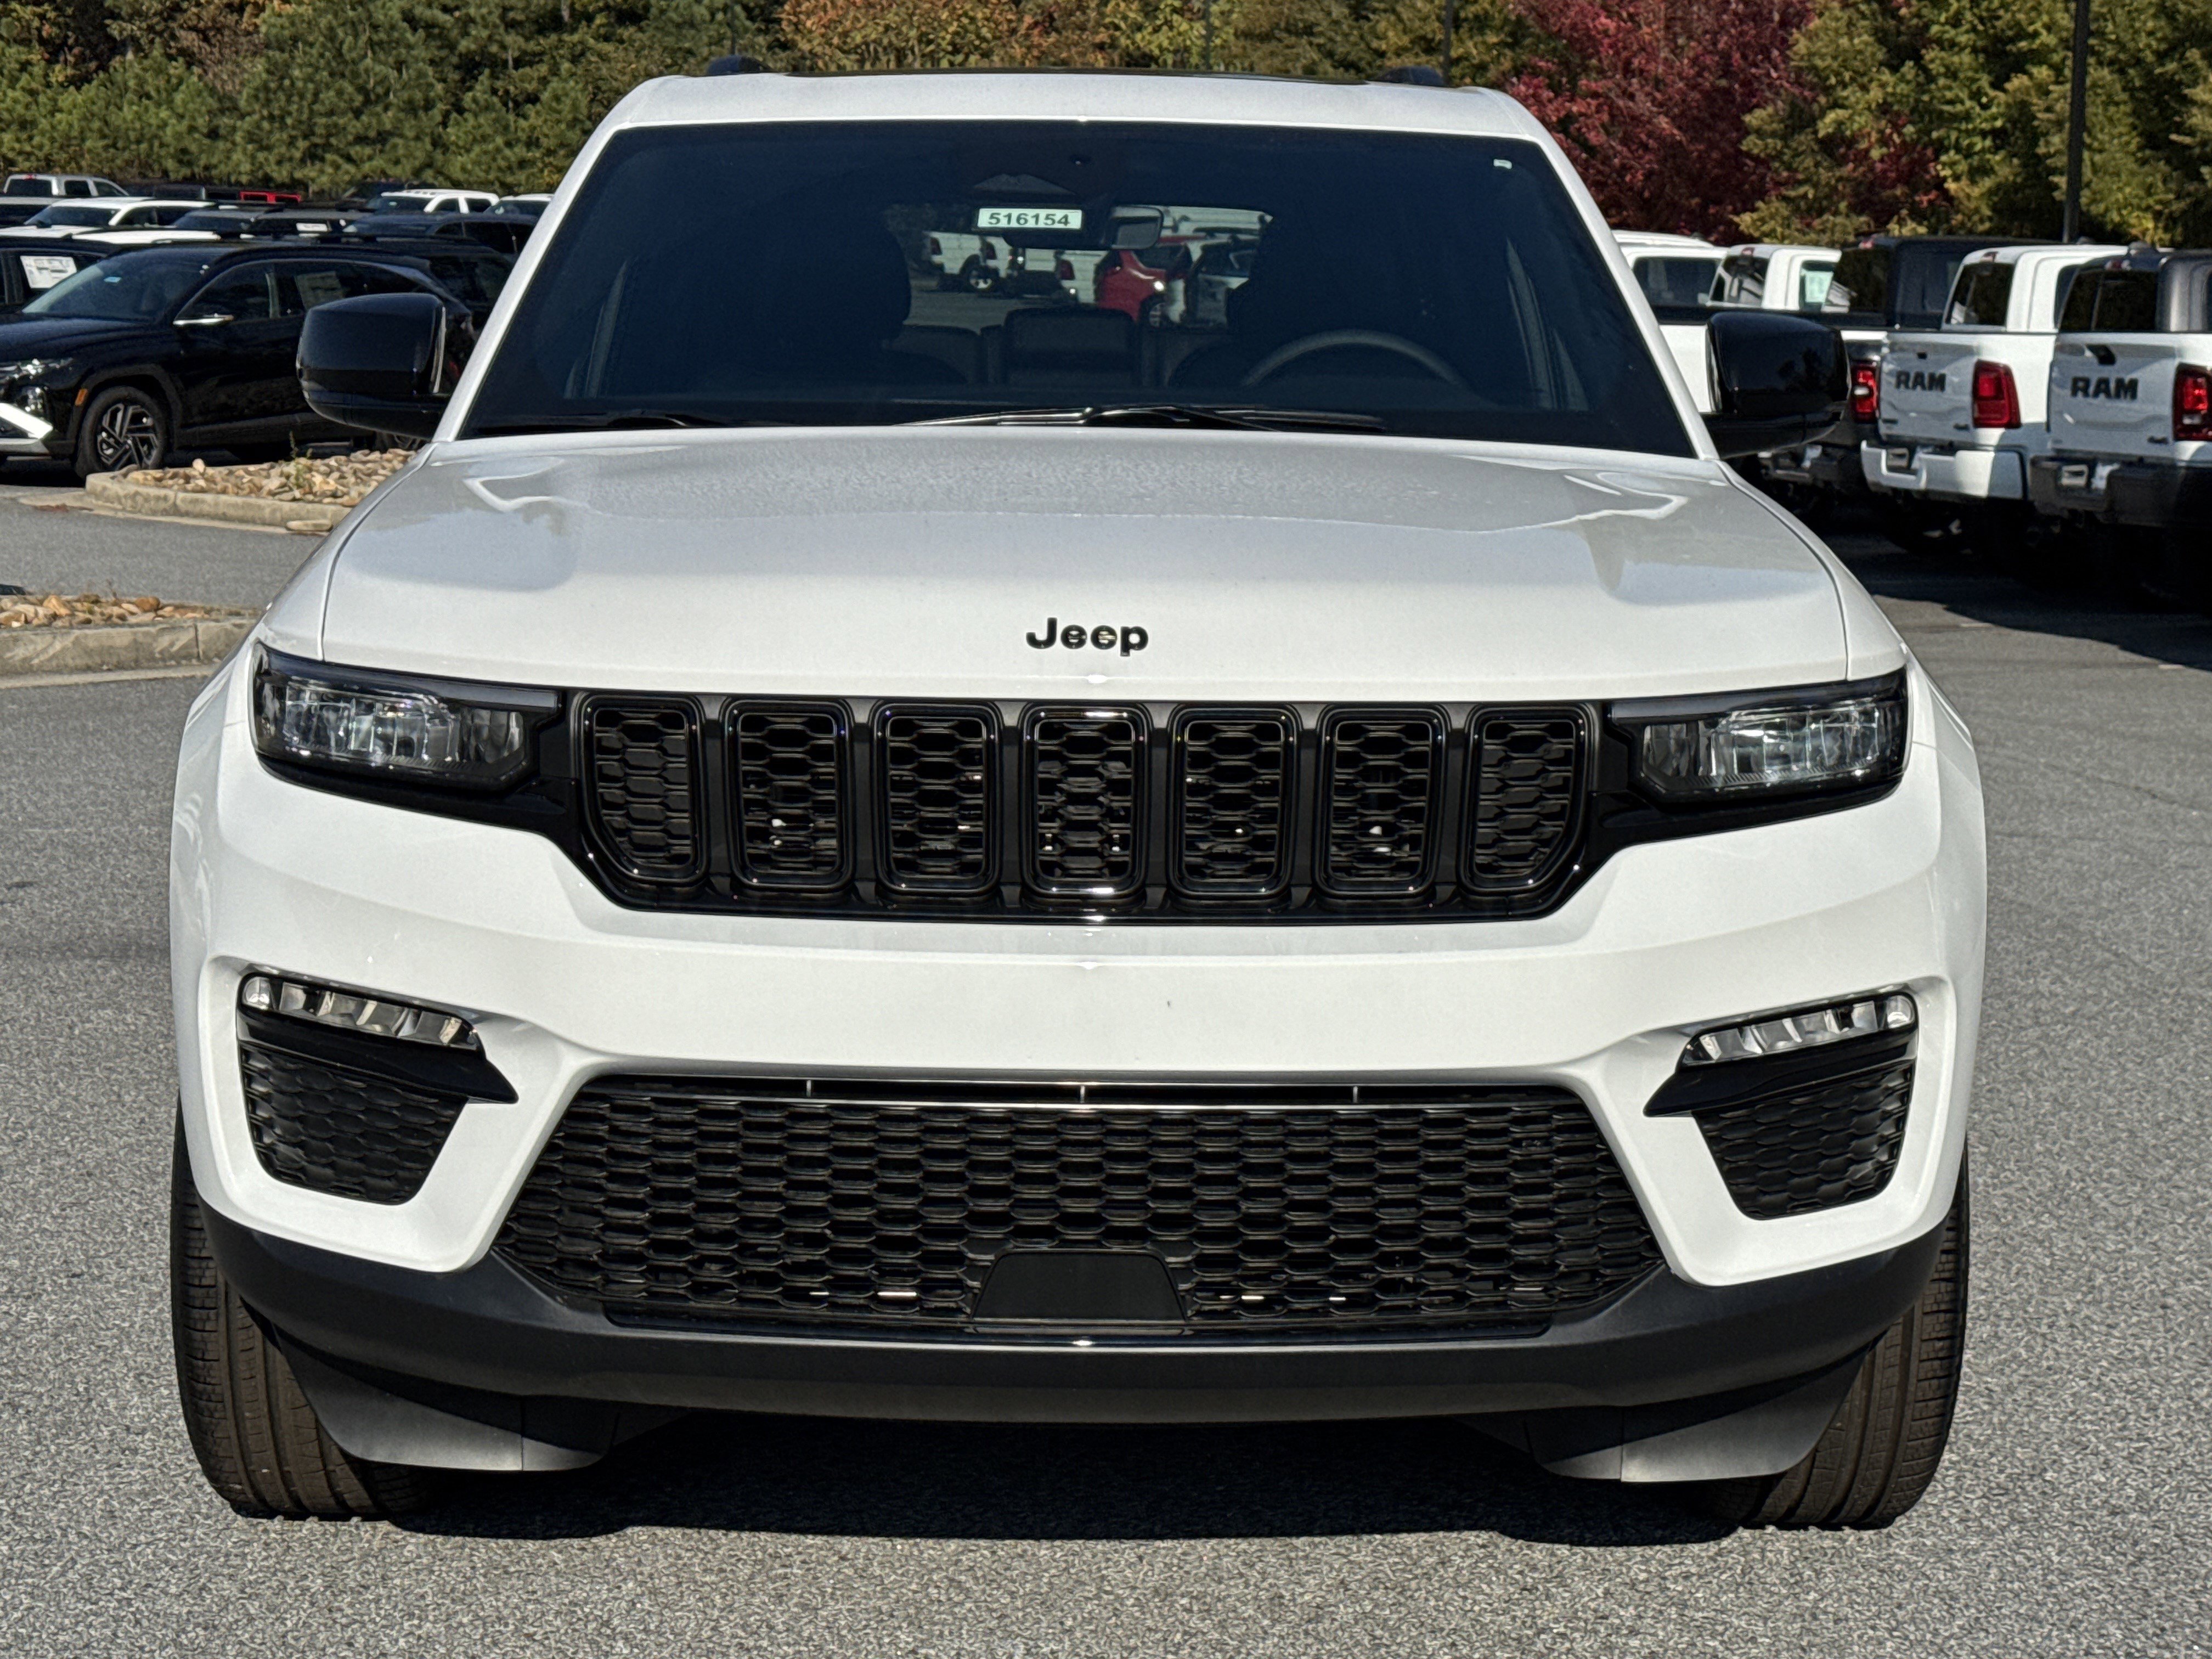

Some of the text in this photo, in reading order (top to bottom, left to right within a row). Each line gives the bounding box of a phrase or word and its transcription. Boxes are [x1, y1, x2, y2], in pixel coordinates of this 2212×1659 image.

[988, 212, 1070, 227] 516154
[1895, 370, 1946, 392] RAM
[2070, 376, 2139, 400] RAM
[1026, 617, 1149, 657] Jeep
